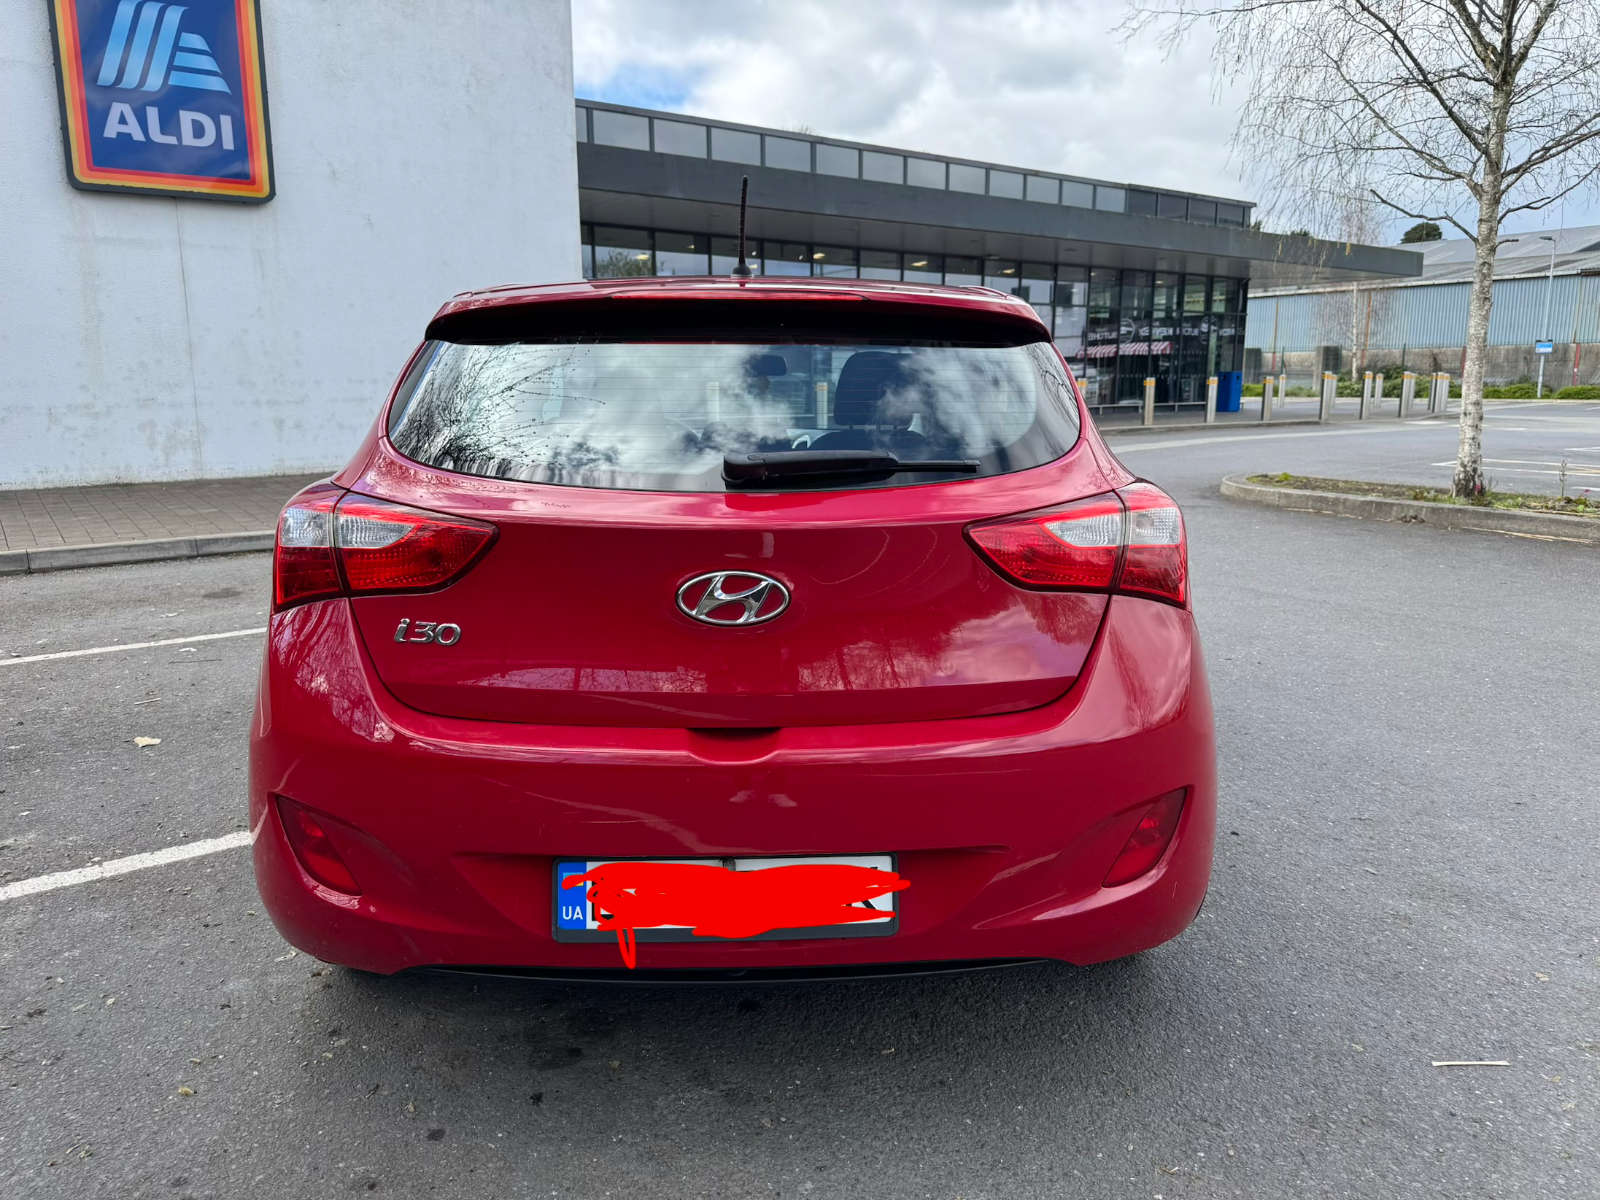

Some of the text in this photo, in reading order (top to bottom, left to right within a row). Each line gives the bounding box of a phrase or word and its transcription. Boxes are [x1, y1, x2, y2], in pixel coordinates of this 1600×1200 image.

[103, 101, 235, 150] ALDI
[394, 618, 461, 646] i30
[562, 905, 584, 920] UA
